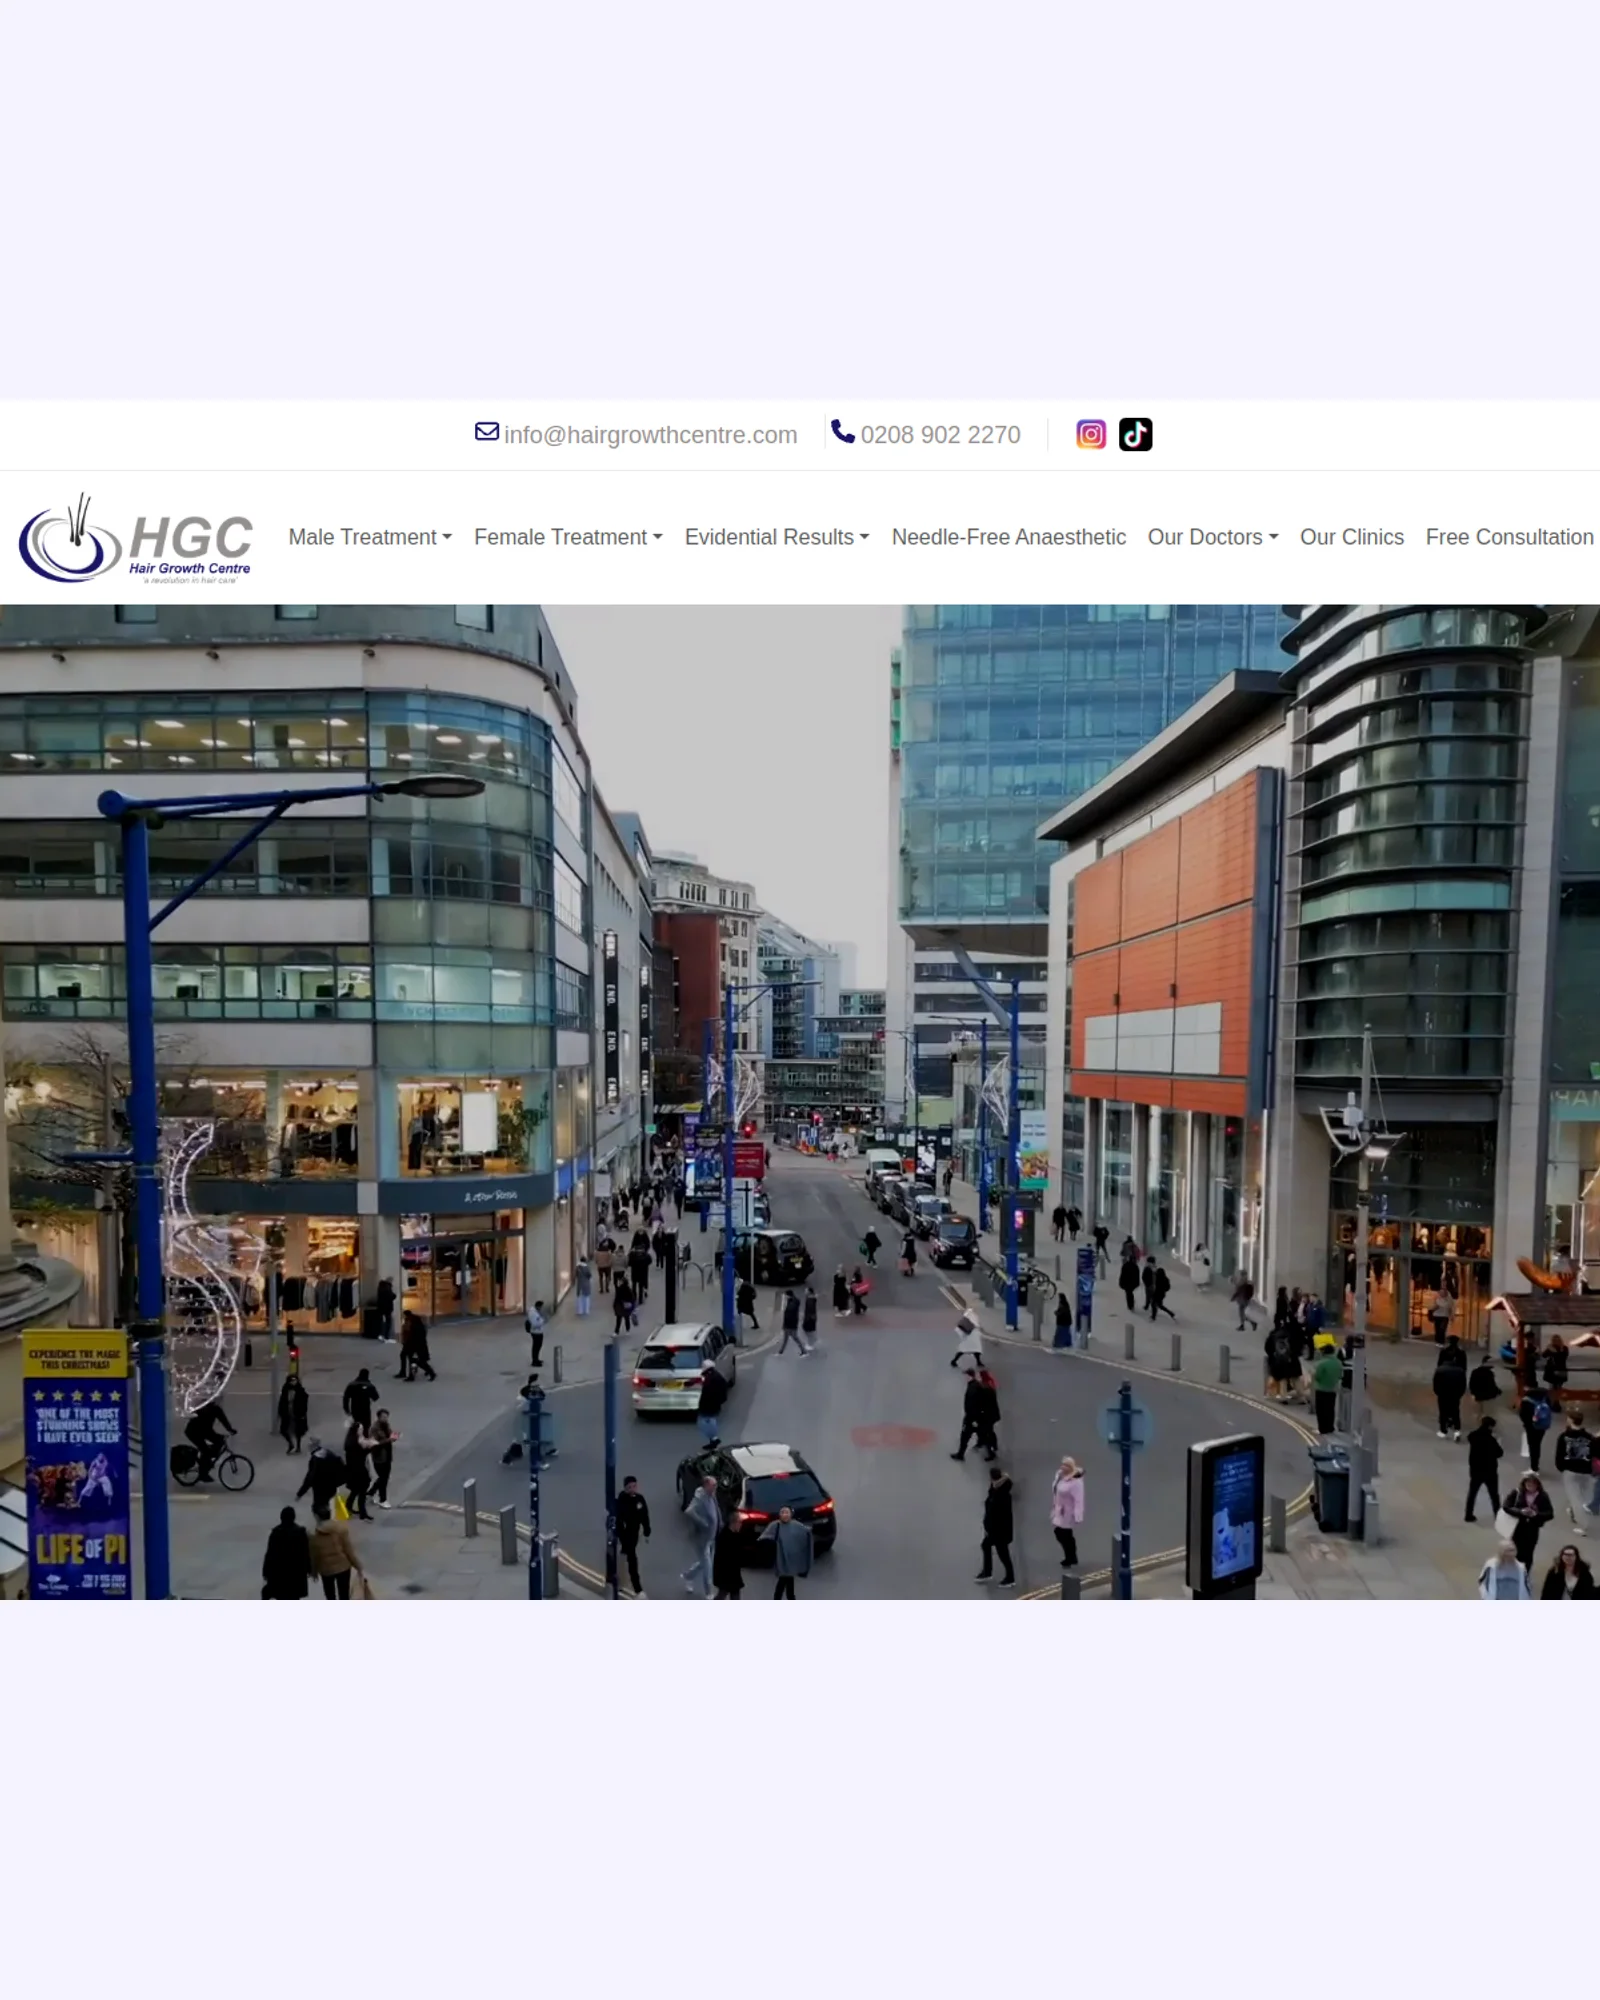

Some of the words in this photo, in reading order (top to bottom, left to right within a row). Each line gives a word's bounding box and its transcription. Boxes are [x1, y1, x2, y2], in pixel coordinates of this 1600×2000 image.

[605, 984, 616, 1007] END.
[606, 1030, 617, 1053] END.
[93, 1408, 120, 1420] MOST
[36, 1534, 85, 1565] LIFE
[85, 1538, 103, 1559] OF
[104, 1534, 127, 1565] PI
